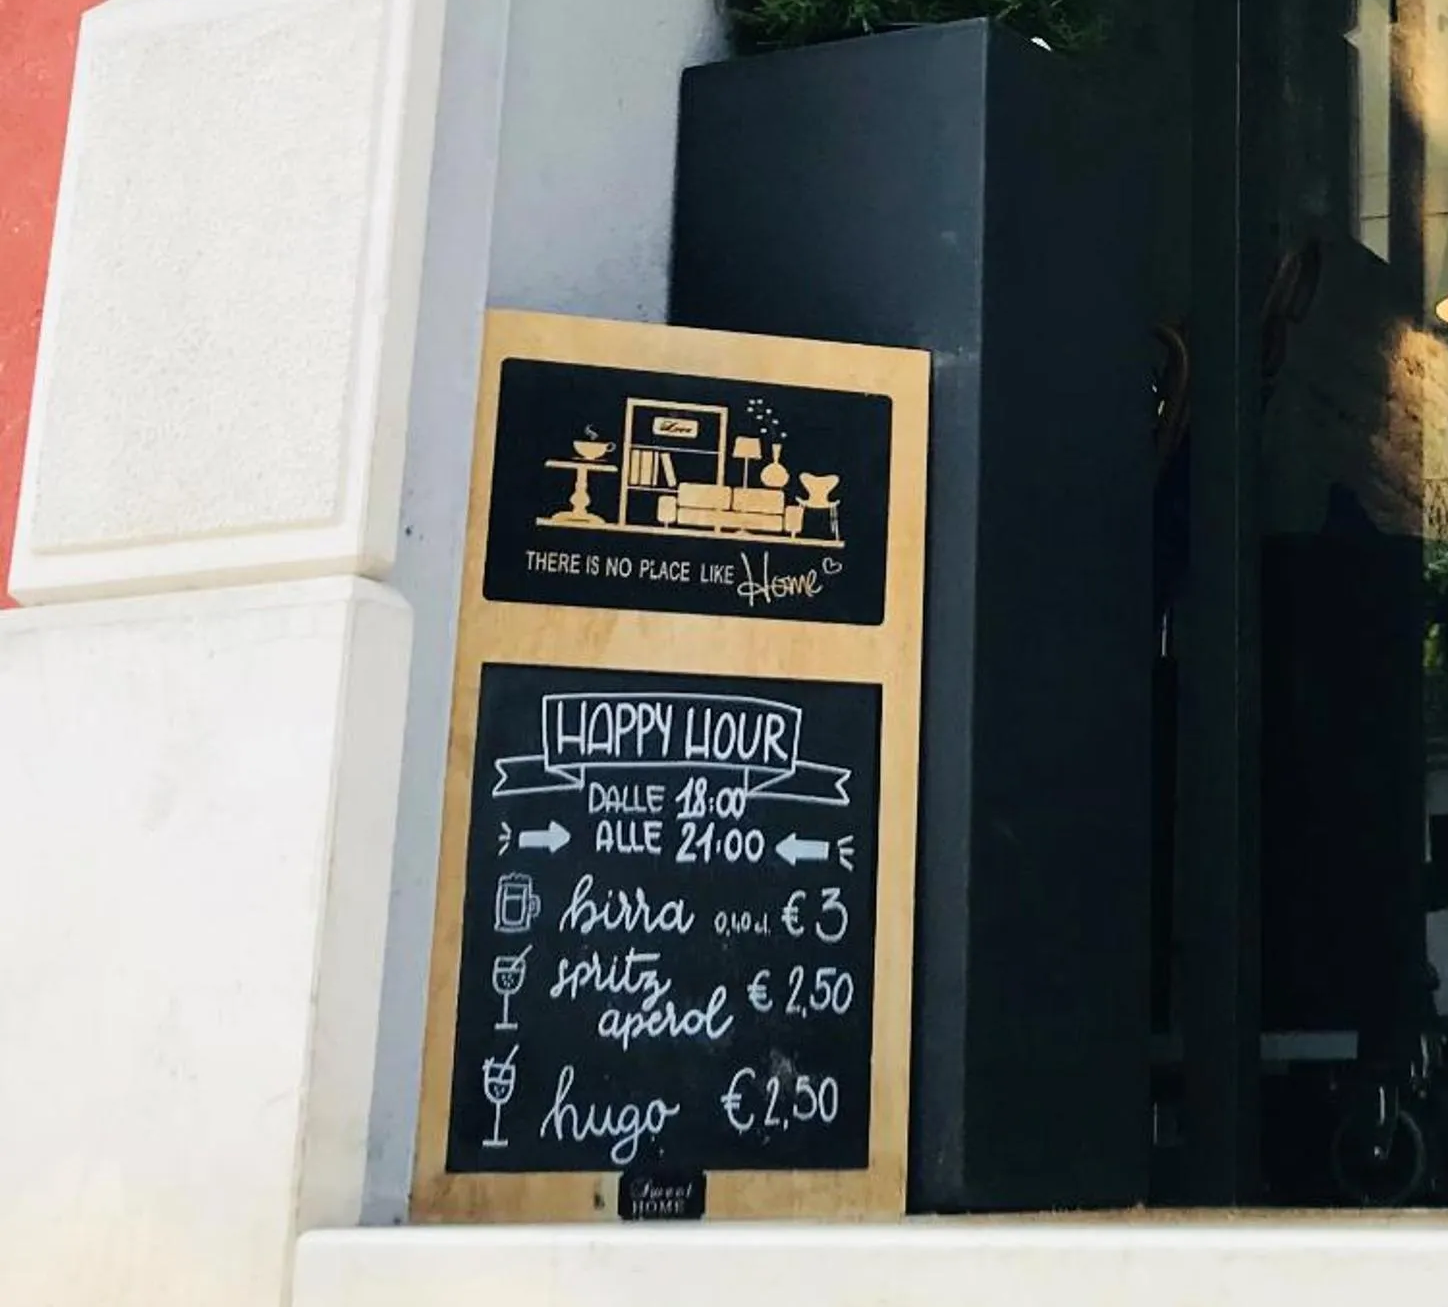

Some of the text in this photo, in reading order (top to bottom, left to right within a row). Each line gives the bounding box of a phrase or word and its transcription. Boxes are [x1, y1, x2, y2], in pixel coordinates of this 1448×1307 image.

[526, 550, 823, 607] THERE IS NO PLACE LIKE Home
[557, 700, 789, 764] HAPPY HOUR
[588, 776, 746, 821] DALLE 18:00
[595, 819, 765, 863] ALLE 21:00
[559, 873, 695, 934] birra
[549, 946, 673, 1011] spritz
[597, 984, 734, 1051] aperol
[540, 1065, 681, 1165] hugo
